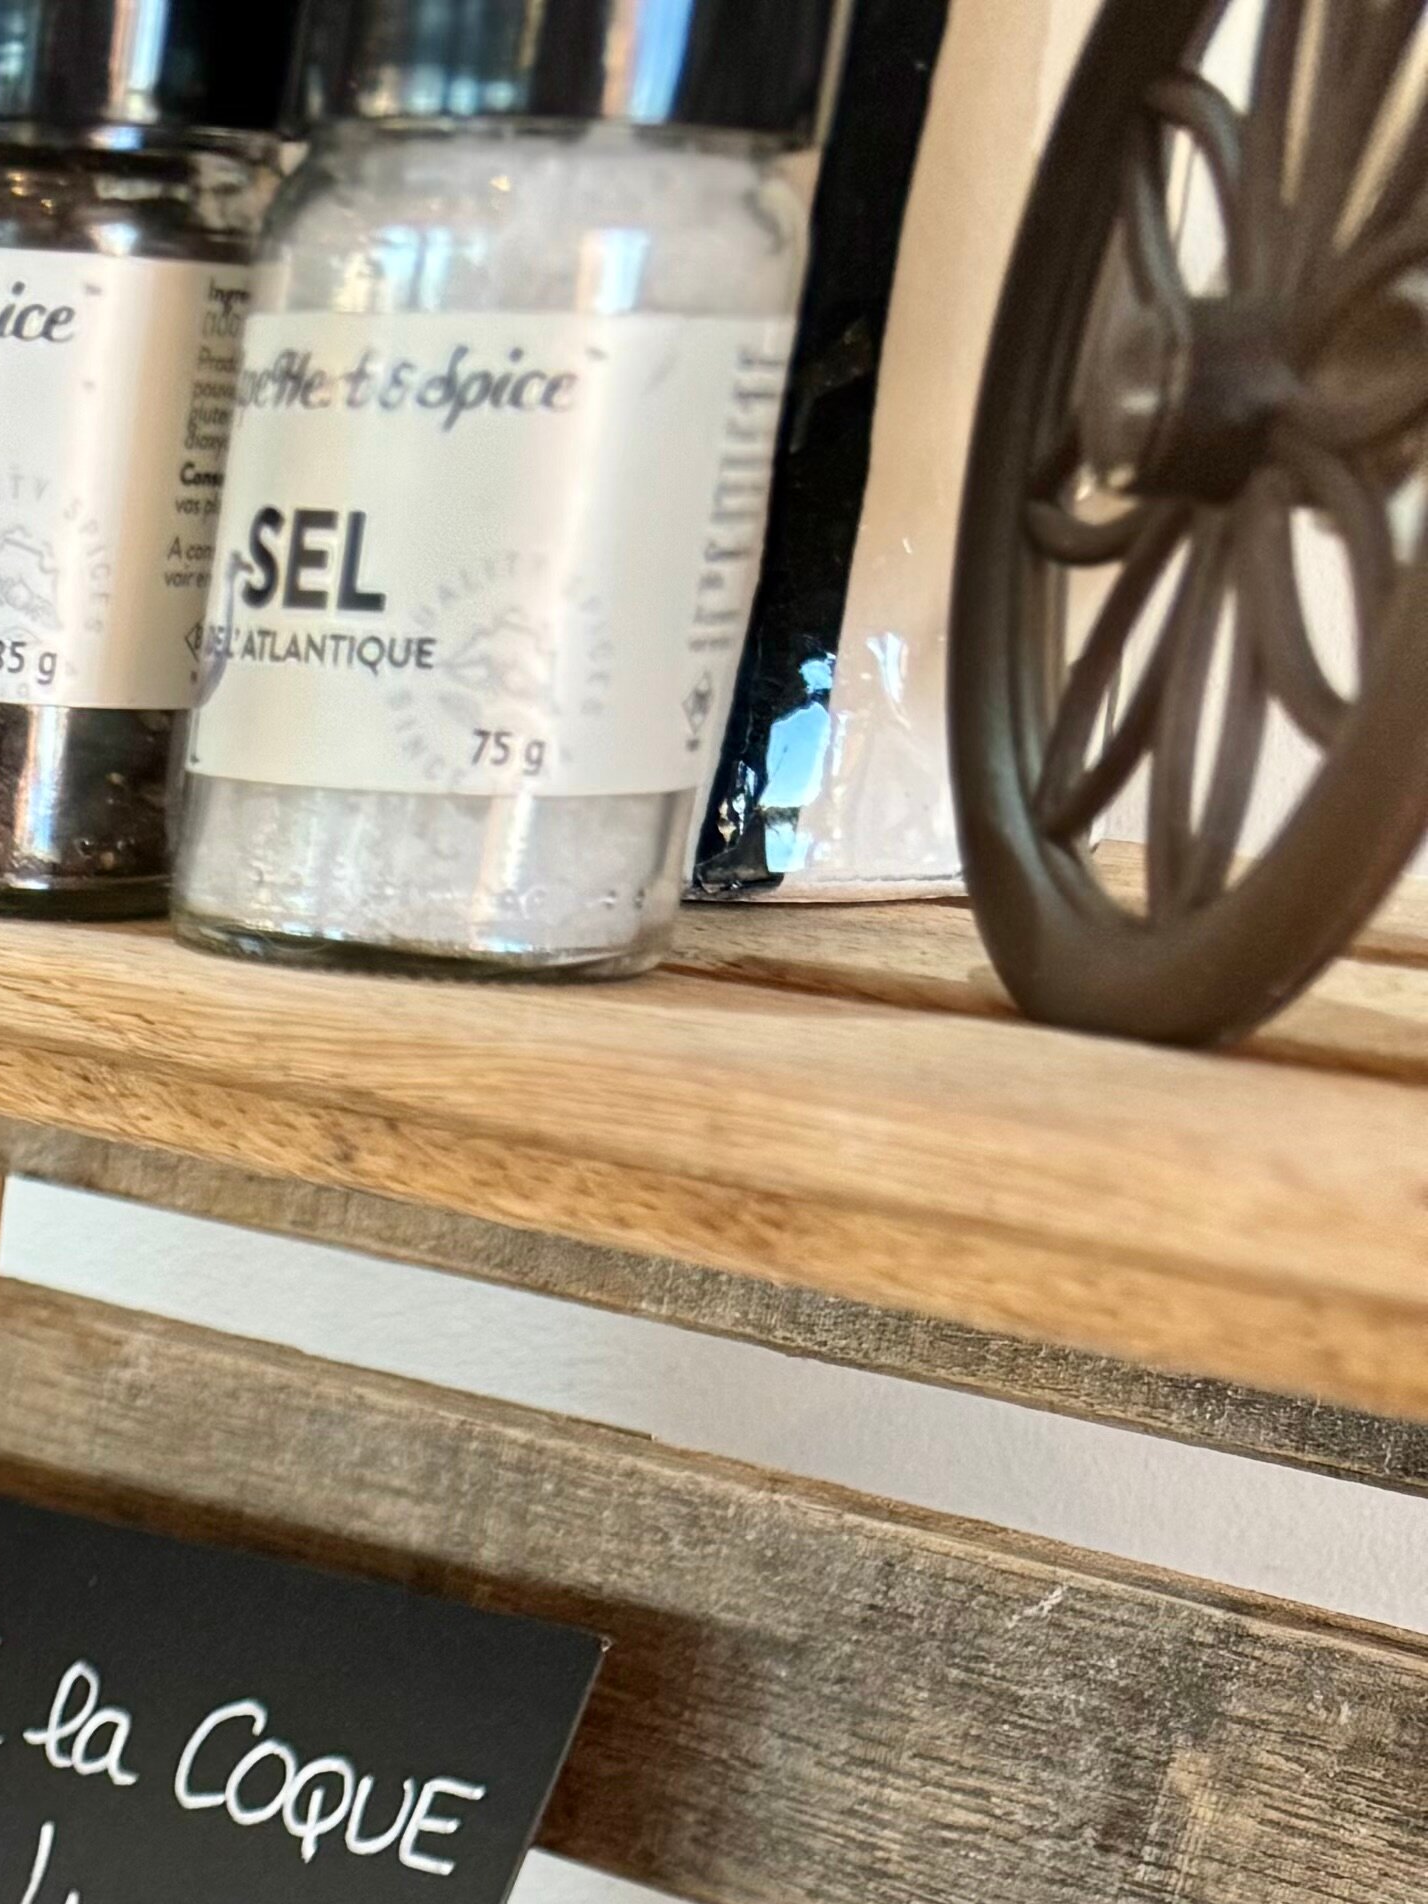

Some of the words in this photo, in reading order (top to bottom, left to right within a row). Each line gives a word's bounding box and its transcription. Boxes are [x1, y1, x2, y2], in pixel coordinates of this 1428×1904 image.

[241, 506, 388, 613] SEL
[36, 649, 58, 686] g
[471, 727, 513, 767] 75
[522, 739, 547, 777] g
[22, 1660, 138, 1786] la
